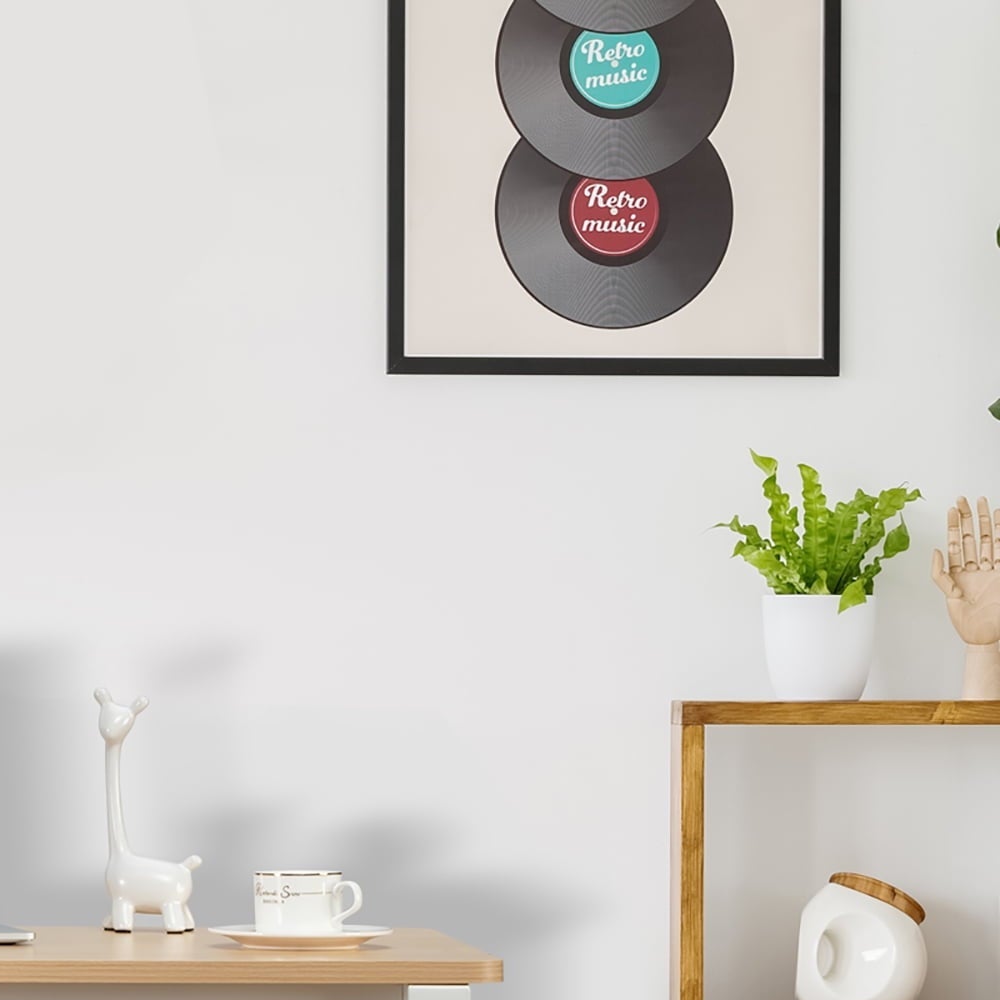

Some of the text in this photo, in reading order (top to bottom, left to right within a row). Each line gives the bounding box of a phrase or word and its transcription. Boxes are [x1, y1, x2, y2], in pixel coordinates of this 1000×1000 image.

[581, 39, 645, 64] Retro
[585, 62, 647, 89] music
[584, 183, 648, 209] Retro
[582, 213, 646, 233] music
